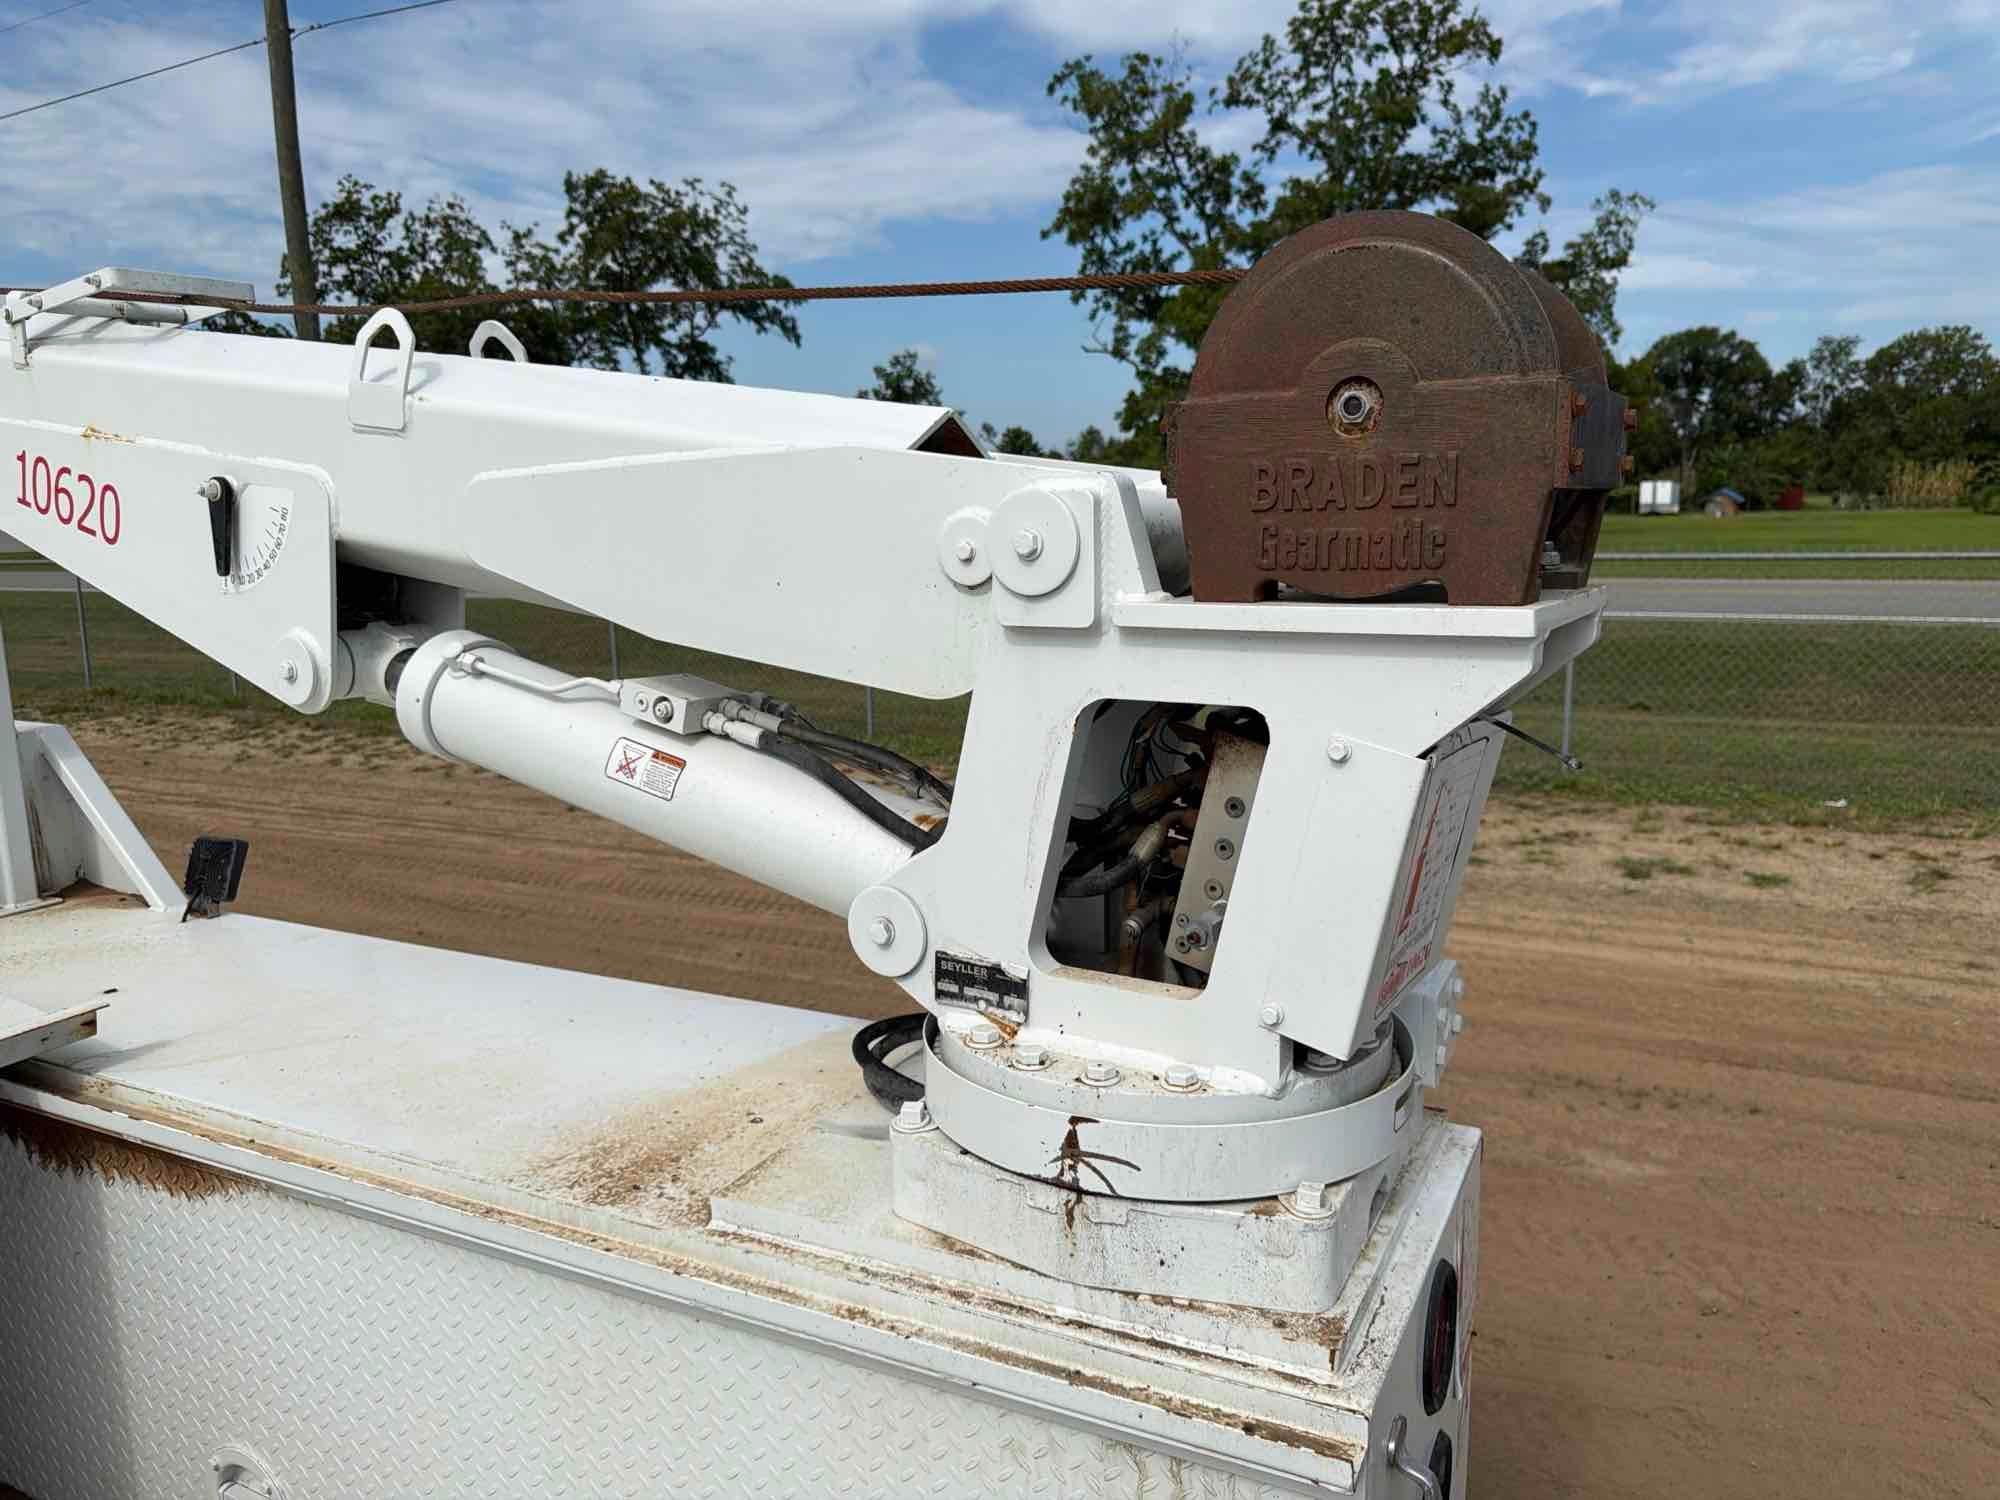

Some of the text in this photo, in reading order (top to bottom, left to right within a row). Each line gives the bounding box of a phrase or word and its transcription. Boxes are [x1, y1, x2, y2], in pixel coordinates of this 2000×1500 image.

[16, 449, 121, 545] 10620
[1250, 450, 1459, 512] BRADEN
[1255, 518, 1447, 571] Gearmatic
